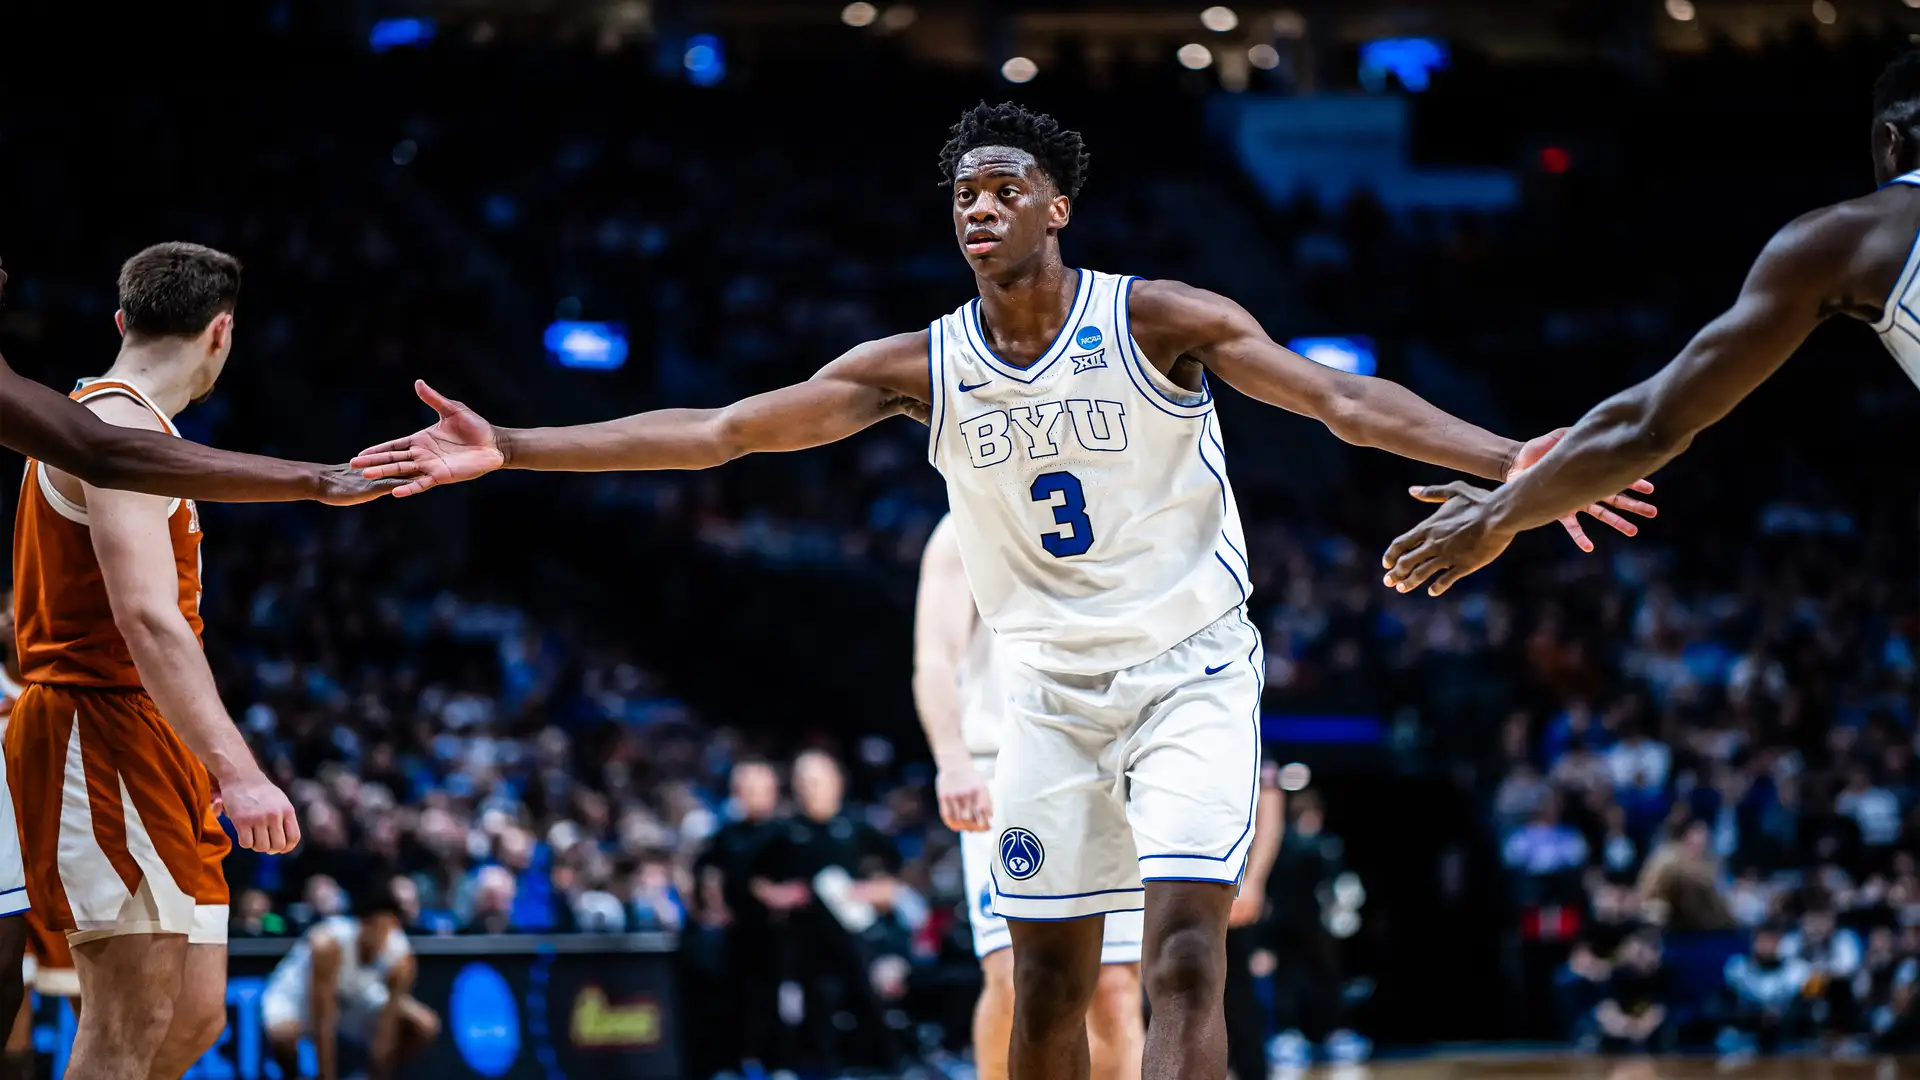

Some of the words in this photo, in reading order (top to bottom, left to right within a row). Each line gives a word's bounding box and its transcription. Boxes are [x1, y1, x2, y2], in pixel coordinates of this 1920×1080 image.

[1081, 334, 1102, 345] NCAA
[959, 399, 1128, 468] BYU
[1030, 470, 1095, 558] 3
[1011, 858, 1026, 871] Y
